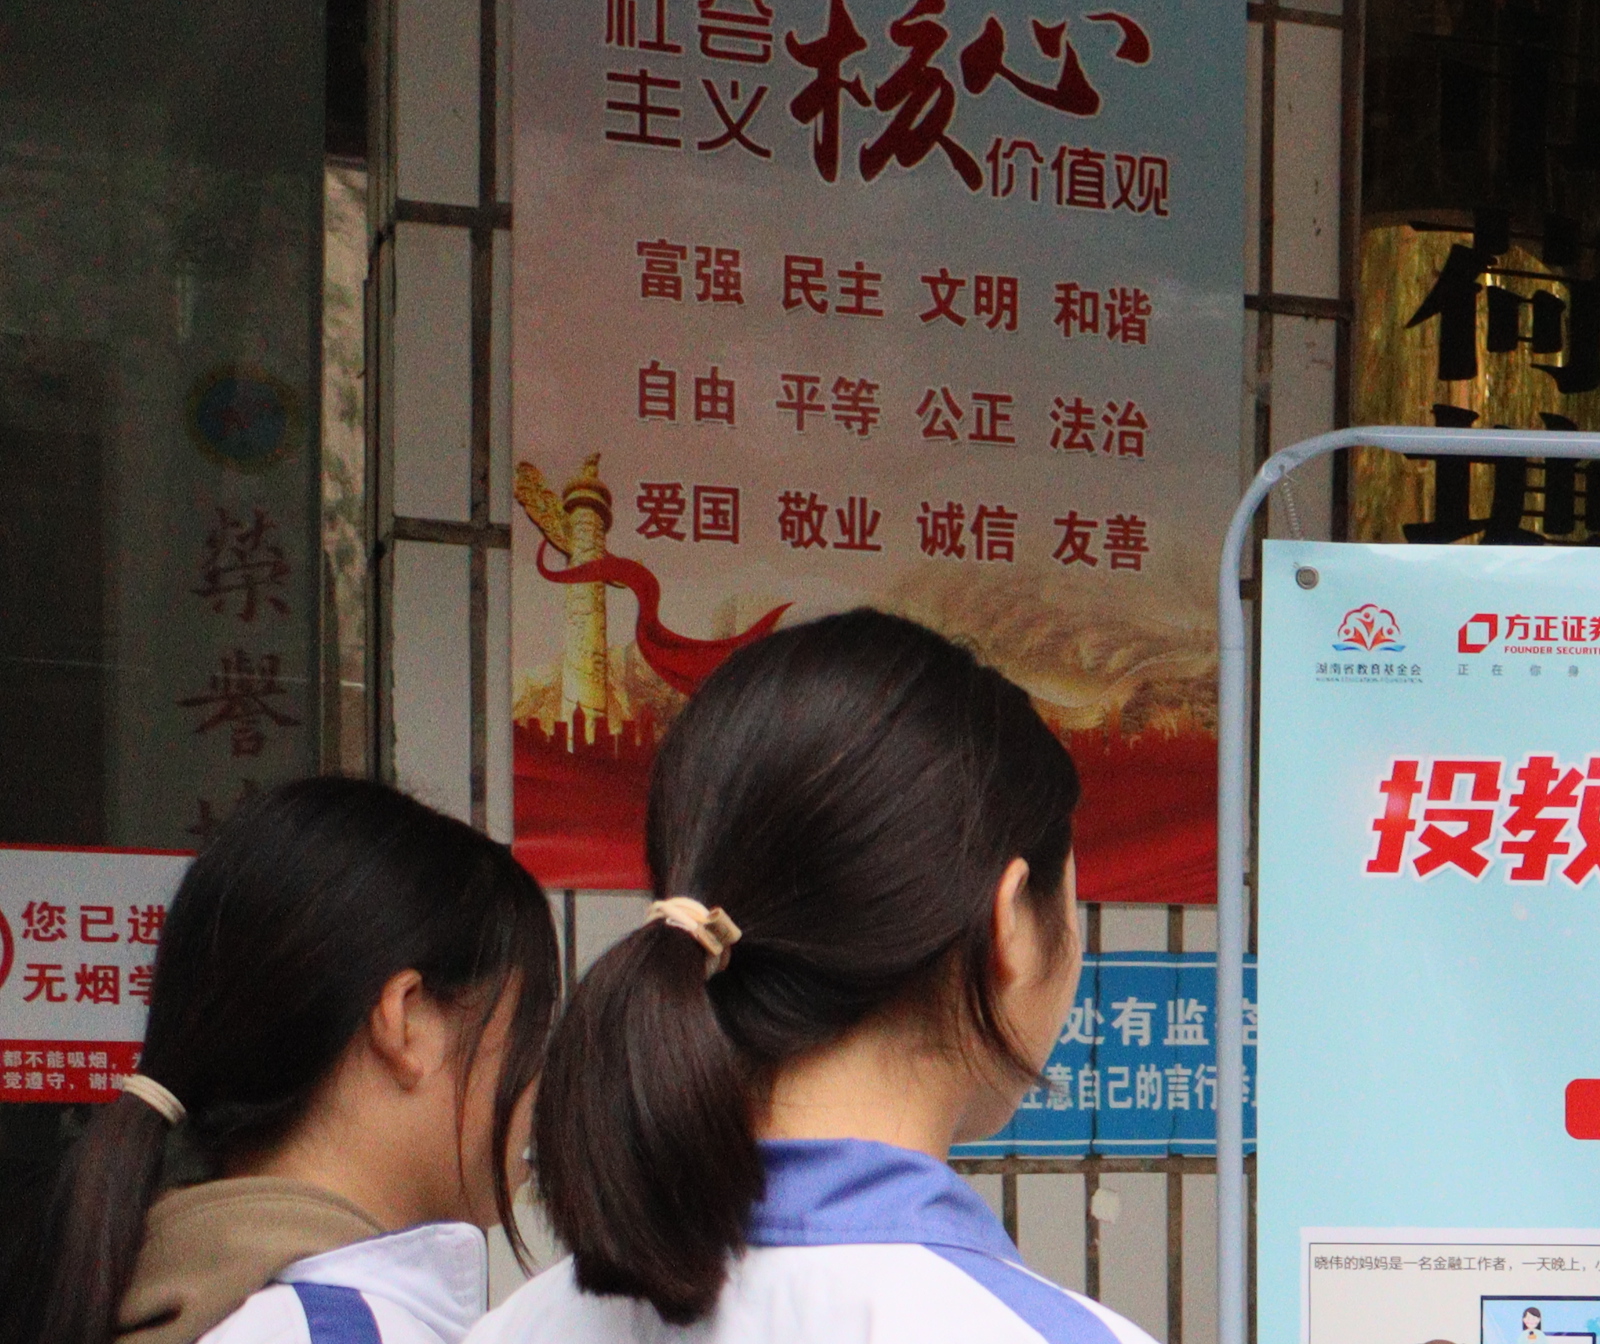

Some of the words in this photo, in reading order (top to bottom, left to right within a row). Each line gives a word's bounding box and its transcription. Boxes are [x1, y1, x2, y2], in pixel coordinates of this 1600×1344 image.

[605, 0, 773, 63] 社会
[605, 67, 773, 158] 主义
[785, 0, 1151, 191] 核心
[985, 137, 1170, 218] 价值观
[635, 239, 745, 305] 富强
[781, 253, 884, 318] 民主
[919, 267, 1019, 331] 文明
[1054, 281, 1152, 345] 和谐
[636, 359, 737, 426] 自由
[776, 372, 881, 436] 平等
[915, 385, 1016, 446] 公正
[1049, 397, 1147, 458] 法治
[635, 481, 741, 544] 爱国
[777, 491, 882, 551] 敬业
[916, 501, 1016, 563] 诚信
[1052, 510, 1149, 571] 友善
[1315, 662, 1422, 678] 湖南省教育基金会
[1504, 646, 1553, 655] FOUNDER
[21, 901, 167, 945] 您已进
[22, 963, 154, 1005] 无烟学
[1018, 1063, 1258, 1112] 意自己的言行
